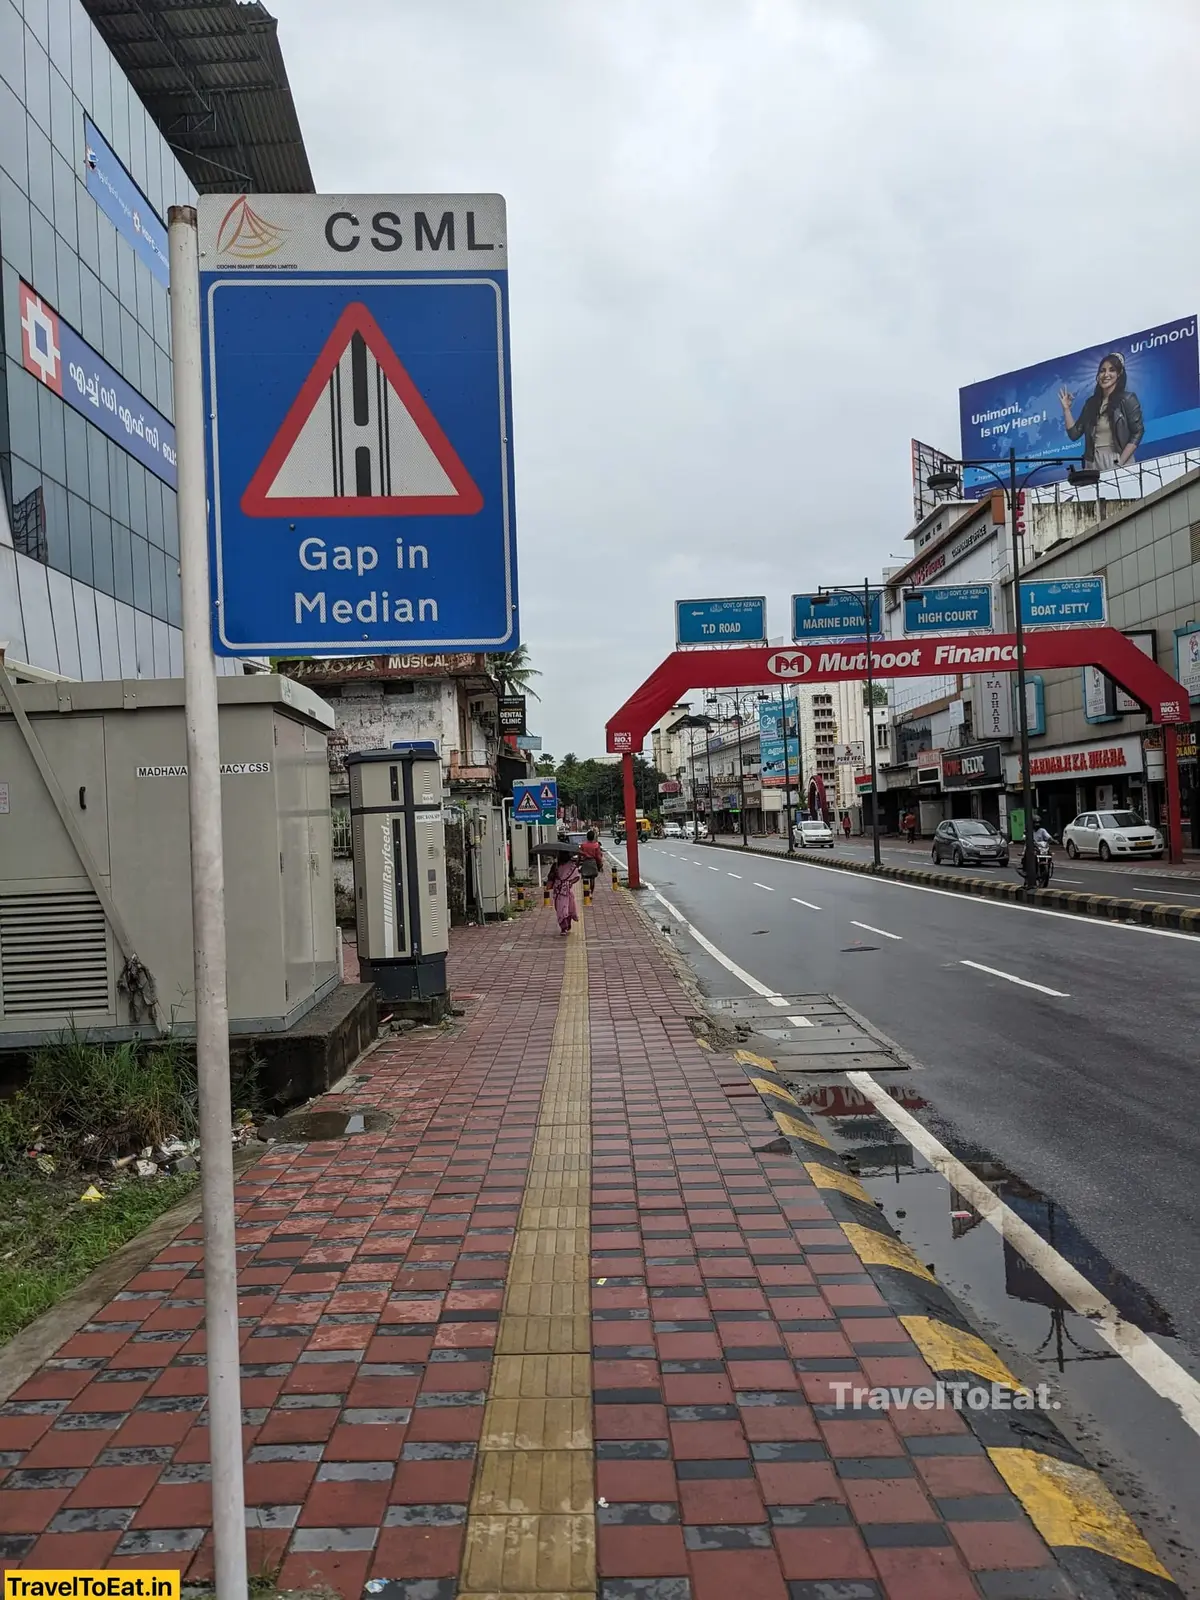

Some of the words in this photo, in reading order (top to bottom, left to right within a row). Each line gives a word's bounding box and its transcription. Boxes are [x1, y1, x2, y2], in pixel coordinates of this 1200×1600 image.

[324, 211, 494, 252] CSML
[1131, 320, 1195, 354] unimoni
[971, 402, 1022, 425] Unimoni,
[981, 427, 991, 438] Is
[993, 422, 1010, 435] my
[299, 537, 379, 576] Gap
[397, 537, 429, 569] in
[295, 592, 438, 625] Median
[918, 612, 942, 624] HIGH
[944, 610, 978, 622] COURT
[1031, 605, 1057, 616] BOAT
[1059, 602, 1089, 615] JETTY
[701, 623, 716, 635] T.D
[719, 622, 741, 634] ROAD
[803, 617, 840, 630] MARINE
[388, 654, 449, 669] MUSICAL
[817, 648, 921, 672] Muthoot
[934, 643, 1027, 665] Finance
[986, 681, 1002, 689] KA
[766, 716, 776, 725] 24
[991, 692, 1001, 733] DHABA
[961, 755, 985, 775] DECOR
[1088, 747, 1127, 769] DHABA
[138, 766, 188, 777] MADHAVA
[219, 764, 246, 774] MACY
[248, 763, 269, 773] CSS
